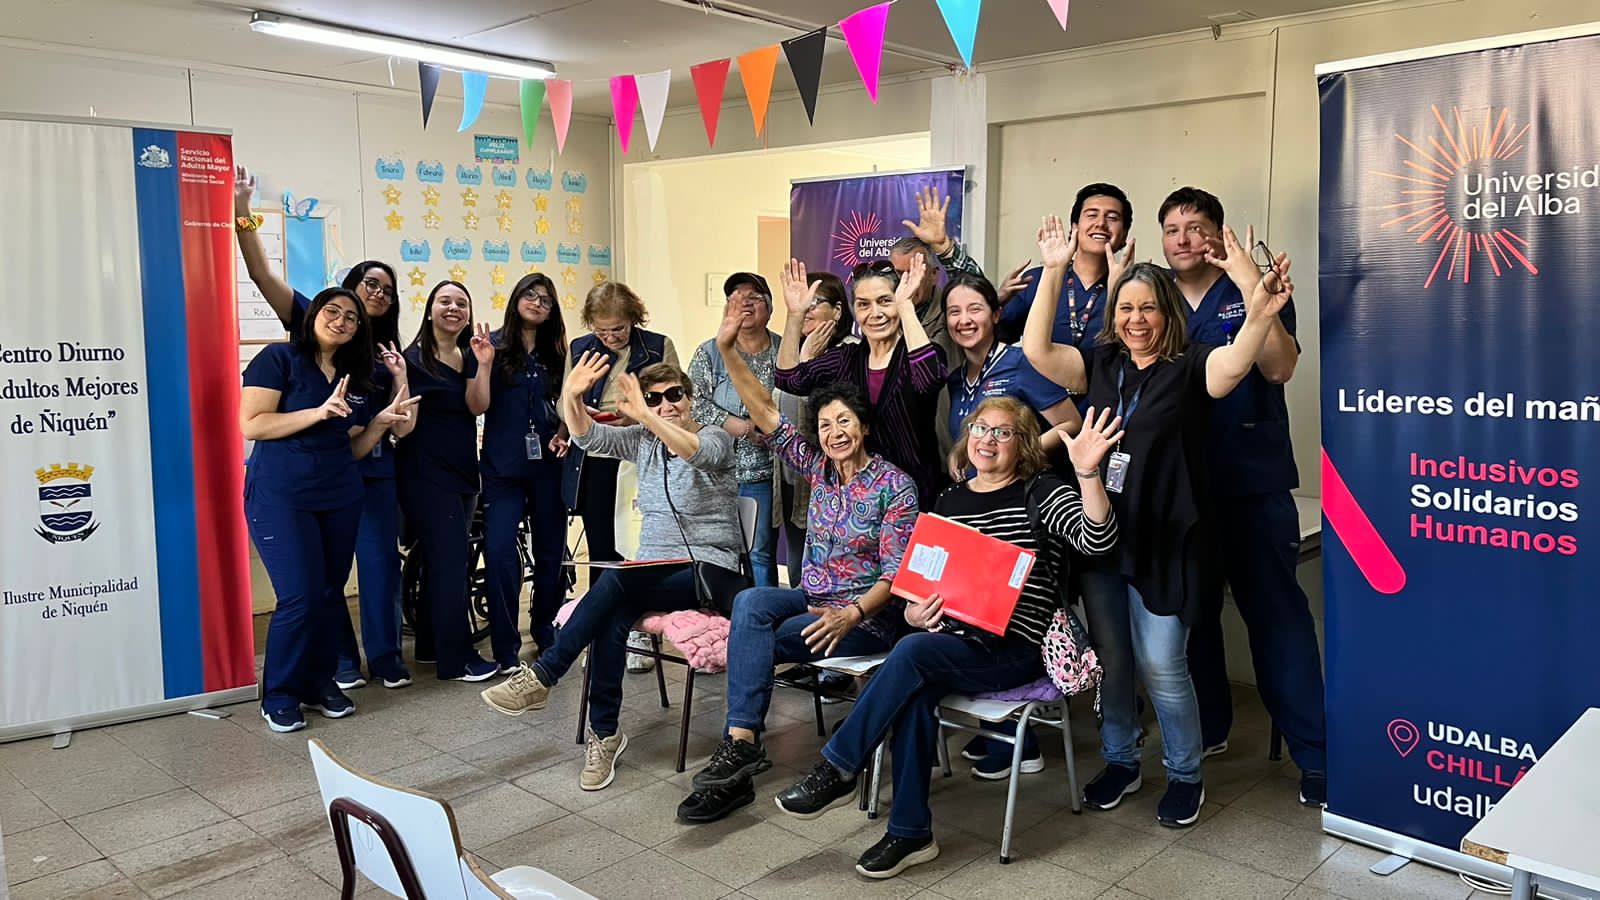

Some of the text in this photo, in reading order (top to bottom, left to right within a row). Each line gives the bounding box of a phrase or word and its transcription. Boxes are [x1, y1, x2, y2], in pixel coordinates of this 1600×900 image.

[180, 147, 210, 156] Servicio
[180, 155, 213, 163] Nacional
[180, 162, 230, 172] Adulto Mayor
[1463, 193, 1581, 220] del Alba
[184, 220, 212, 228] Gobierno
[859, 246, 891, 257] del Alb
[0, 342, 125, 363] entro Diurno
[0, 377, 139, 401] dultos Mejores
[1337, 388, 1454, 414] Líderes
[1464, 391, 1514, 417] del
[10, 414, 33, 434] de
[1408, 452, 1580, 488] Inclusivos
[1409, 484, 1579, 522] Solidarios
[1408, 513, 1578, 556] Humanos
[3, 576, 139, 606] Ilustre Municipalidad
[41, 599, 109, 619] de Ñiquén
[1427, 720, 1538, 763] UDALBA
